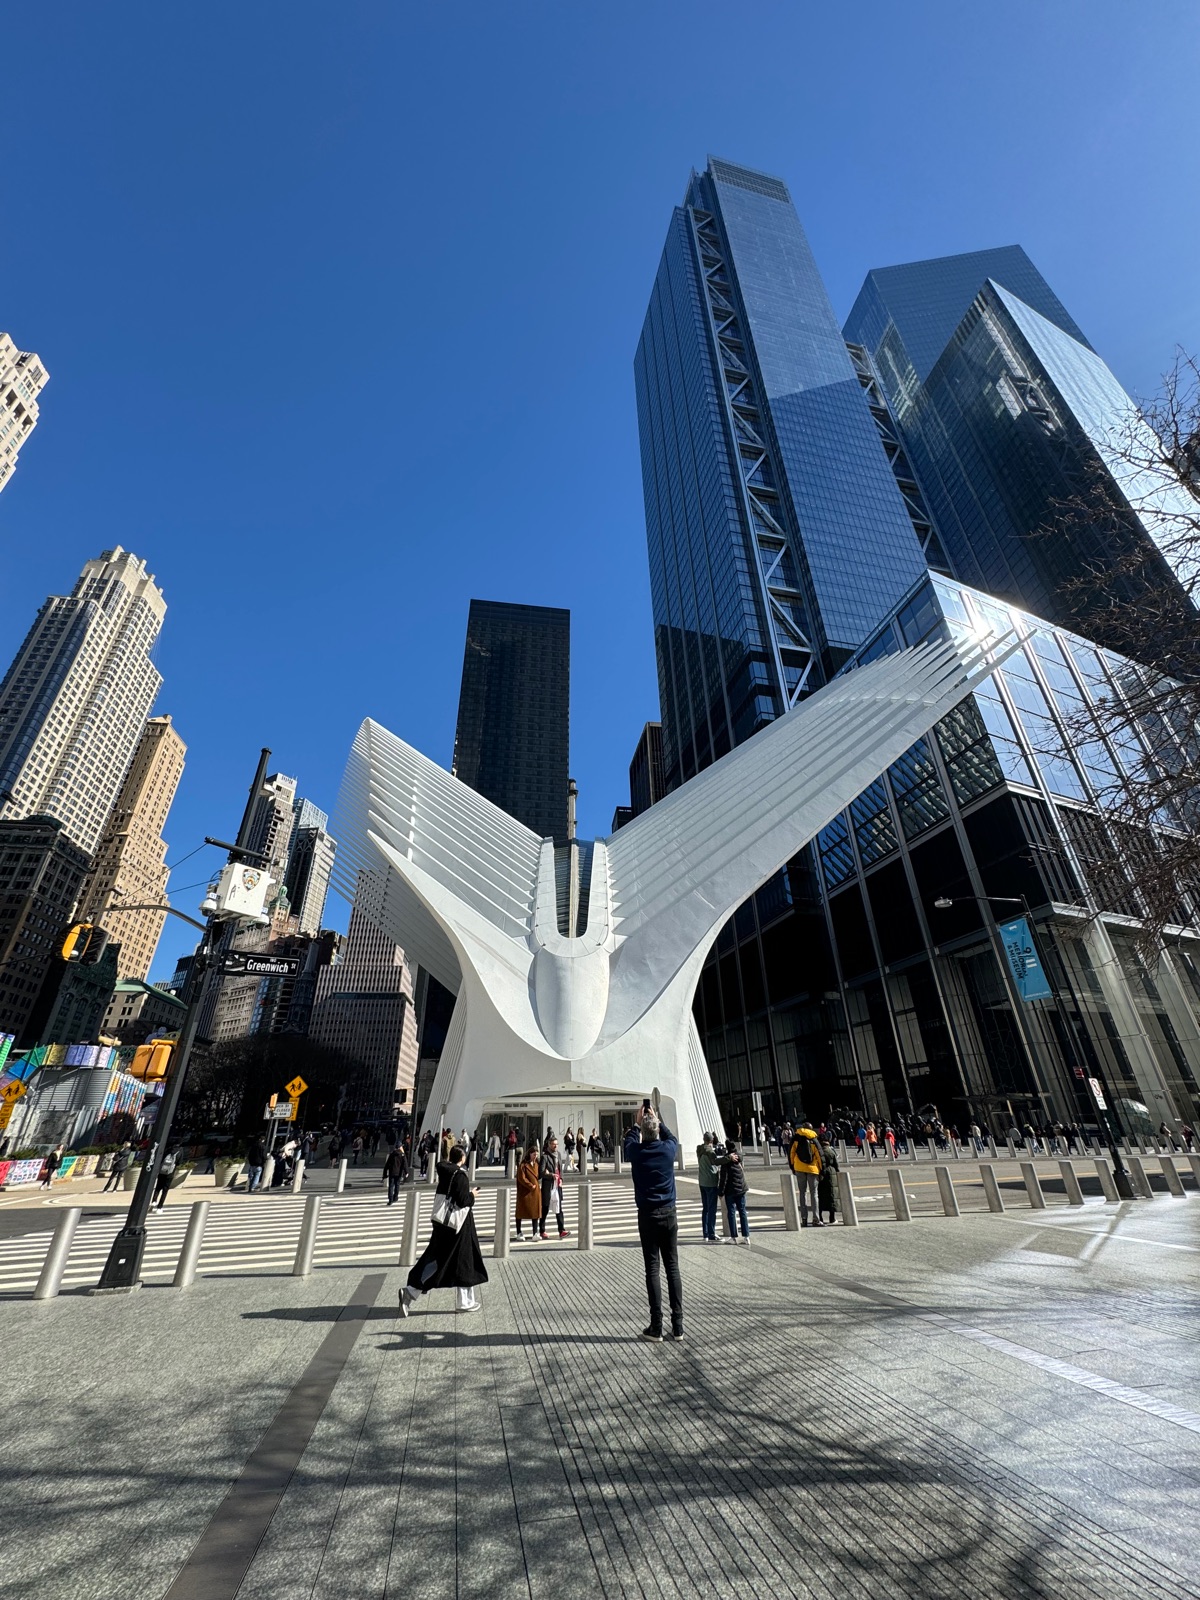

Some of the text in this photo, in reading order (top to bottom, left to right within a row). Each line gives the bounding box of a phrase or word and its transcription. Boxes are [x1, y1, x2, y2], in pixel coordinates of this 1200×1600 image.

[246, 959, 289, 974] Greenwich
[1009, 949, 1024, 980] MUSEUM
[1024, 946, 1038, 969] 9/11
